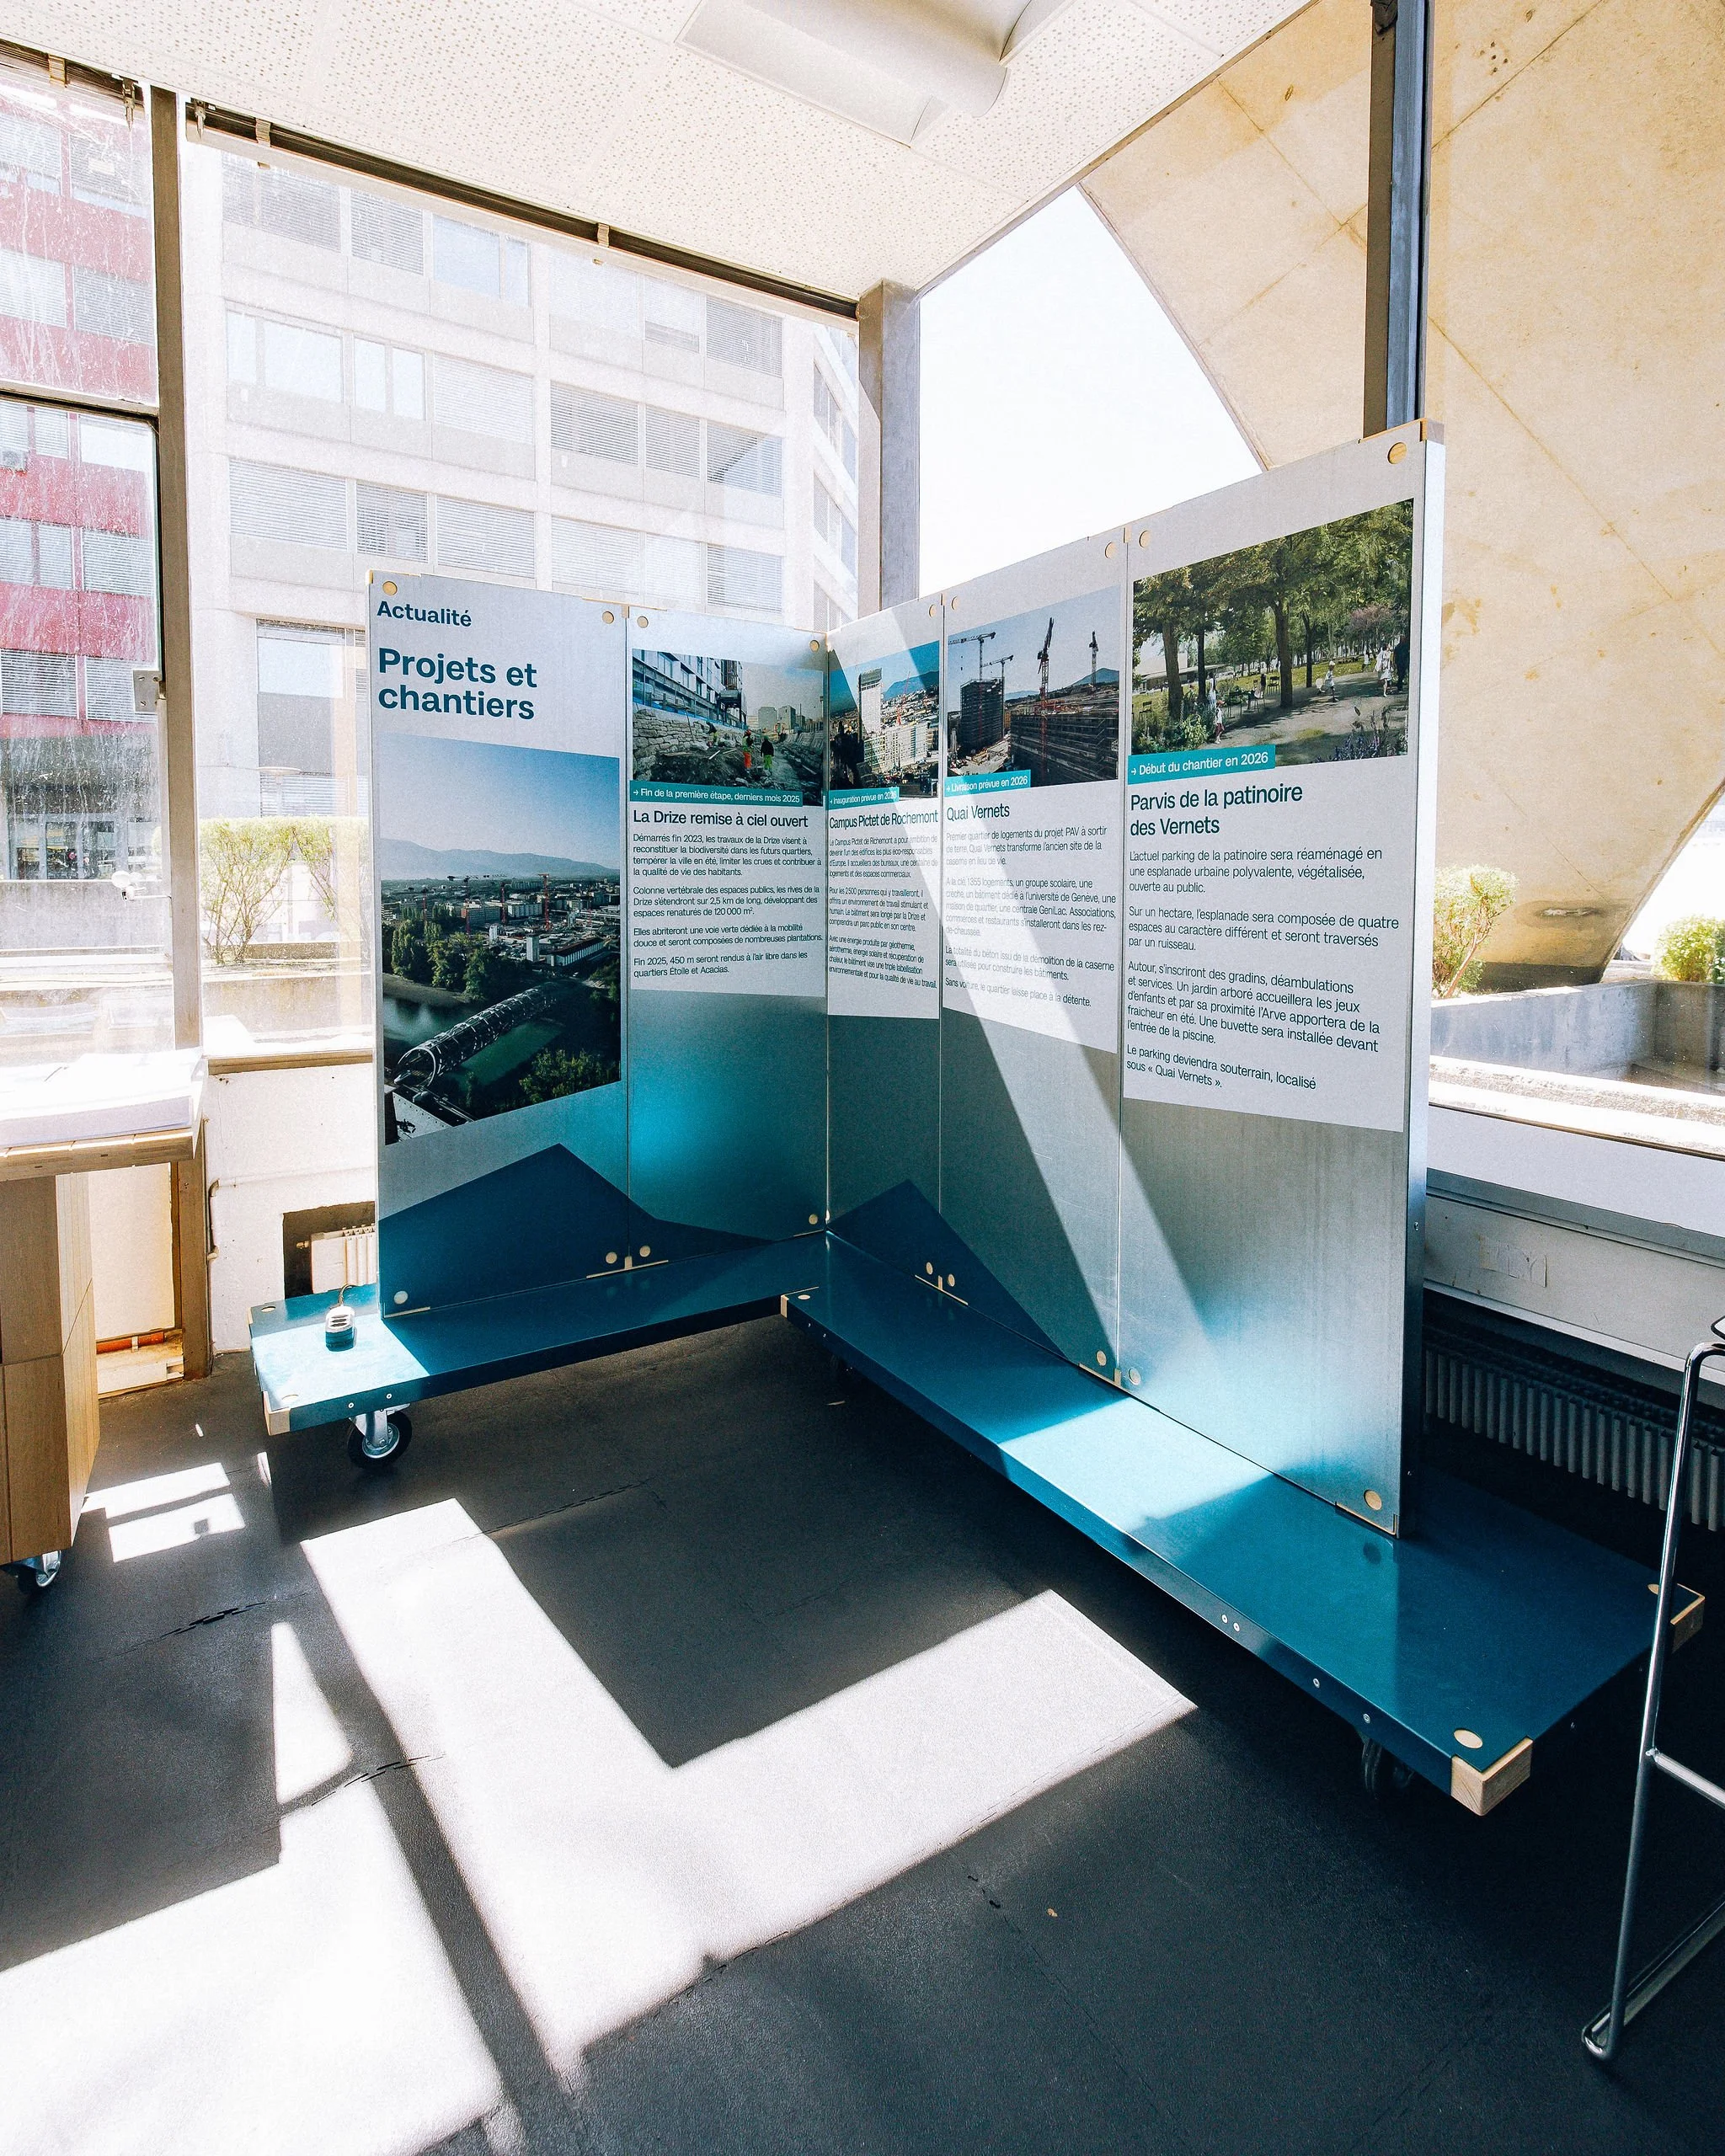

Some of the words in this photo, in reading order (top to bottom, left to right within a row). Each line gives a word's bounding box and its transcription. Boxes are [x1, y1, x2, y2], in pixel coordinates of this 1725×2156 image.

[377, 600, 471, 627] Actualité
[379, 648, 495, 684] Projets
[506, 664, 537, 687] et
[378, 685, 534, 719] chantiers
[1139, 762, 1166, 775] Début
[1167, 761, 1179, 771] du
[1182, 757, 1222, 771] chantier
[1225, 757, 1238, 766] en
[1241, 751, 1268, 765] 2026
[951, 782, 977, 791] Livraison
[978, 779, 1000, 790] prévue
[1010, 775, 1028, 785] 2026
[675, 790, 708, 798] première
[709, 791, 733, 800] étape,
[734, 792, 763, 801] derniers
[860, 793, 876, 803] prévue
[1130, 792, 1175, 810] Parvis
[1179, 791, 1199, 808] de
[1204, 789, 1218, 806] la
[1223, 783, 1302, 808] patinoire
[633, 810, 649, 822] La
[654, 810, 686, 823] Drize
[690, 812, 732, 825] remise
[735, 812, 744, 825] à
[746, 814, 766, 825] ciel
[770, 816, 808, 827] ouvert
[829, 817, 857, 830] Campus
[858, 814, 879, 826] Pictet
[880, 814, 889, 825] de
[891, 810, 937, 825] Rochemont
[947, 806, 968, 821] Quai
[971, 803, 1009, 818] Vernets
[991, 830, 999, 839] de
[1000, 830, 1033, 841] logements
[1033, 829, 1042, 837] du
[1044, 828, 1063, 839] projet
[1065, 827, 1079, 835] PAV
[1081, 825, 1086, 835] à
[1087, 825, 1107, 835] sortir
[1130, 819, 1156, 835] des
[1160, 816, 1220, 834] Vernets
[633, 833, 670, 841] Démarrés
[683, 835, 703, 843] 2023,
[1130, 851, 1159, 861] L'actuel
[1162, 851, 1194, 862] parking
[1197, 850, 1210, 860] de
[1212, 850, 1220, 860] la
[1223, 849, 1267, 862] patinoire
[1270, 851, 1293, 860] sera
[1296, 846, 1363, 862] réaménagé
[1366, 850, 1381, 859] en
[642, 867, 667, 876] qualité
[1146, 867, 1191, 878] esplanade
[1194, 866, 1229, 876] urbaine
[1232, 866, 1294, 879] polyvalente,
[1297, 865, 1364, 879] végétalisée,
[1129, 882, 1161, 894] ouverte
[1162, 883, 1173, 892] au
[1177, 882, 1204, 894] public.
[1129, 905, 1142, 915] Sur
[1158, 907, 1194, 920] hectare,
[1196, 909, 1249, 921] l'esplanade
[1252, 913, 1274, 922] sera
[1277, 913, 1335, 926] composée
[1339, 915, 1354, 926] de
[1358, 916, 1398, 929] quatre
[1129, 923, 1162, 932] espaces
[1164, 925, 1175, 933] au
[1178, 924, 1221, 937] caractère
[1225, 926, 1268, 939] différent
[1271, 930, 1282, 940] et
[1284, 931, 1320, 942] seront
[1323, 931, 1378, 947] traversés
[1129, 938, 1142, 947] par
[1157, 938, 1195, 950] ruisseau.
[633, 969, 667, 978] quartiers
[669, 966, 689, 974] Étoile
[1128, 961, 1156, 974] Autour,
[1158, 963, 1206, 978] s'inscriront
[1209, 969, 1226, 980] des
[1228, 972, 1267, 985] gradins,
[1270, 974, 1354, 993] déambulations
[1128, 976, 1136, 985] et
[1138, 979, 1173, 990] services.
[1177, 981, 1188, 991] Un
[1191, 983, 1217, 995] jardin
[1220, 987, 1252, 1000] arboré
[1256, 992, 1312, 1006] accueillera
[1316, 996, 1332, 1009] les
[1335, 999, 1359, 1012] jeux
[1127, 990, 1165, 1004] d'enfants
[1167, 996, 1177, 1006] et
[1178, 999, 1194, 1008] par
[1196, 1001, 1207, 1010] sa
[1210, 1003, 1255, 1017] proximité
[1258, 1006, 1285, 1021] l'Arve
[1289, 1013, 1346, 1029] apportera
[1349, 1019, 1365, 1031] de
[1369, 1021, 1380, 1033] la
[1127, 1019, 1156, 1033] l'entrée
[1158, 1025, 1169, 1035] de
[1172, 1027, 1179, 1038] la
[1183, 1029, 1215, 1043] piscine.
[1167, 1012, 1178, 1021] en
[1180, 1011, 1196, 1024] été.
[1199, 1016, 1217, 1027] Une
[1220, 1018, 1258, 1033] buvette
[1261, 1027, 1284, 1038] sera
[1287, 1027, 1332, 1044] installée
[1336, 1036, 1378, 1052] devant
[1126, 1060, 1146, 1071] sous
[1155, 1065, 1175, 1077] Quai
[1178, 1069, 1212, 1085] Vernets
[1127, 1044, 1136, 1054] Le
[1139, 1049, 1170, 1063] parking
[1172, 1054, 1217, 1070] deviendra
[1220, 1063, 1273, 1082] souterrain,
[1276, 1071, 1316, 1089] localisé
